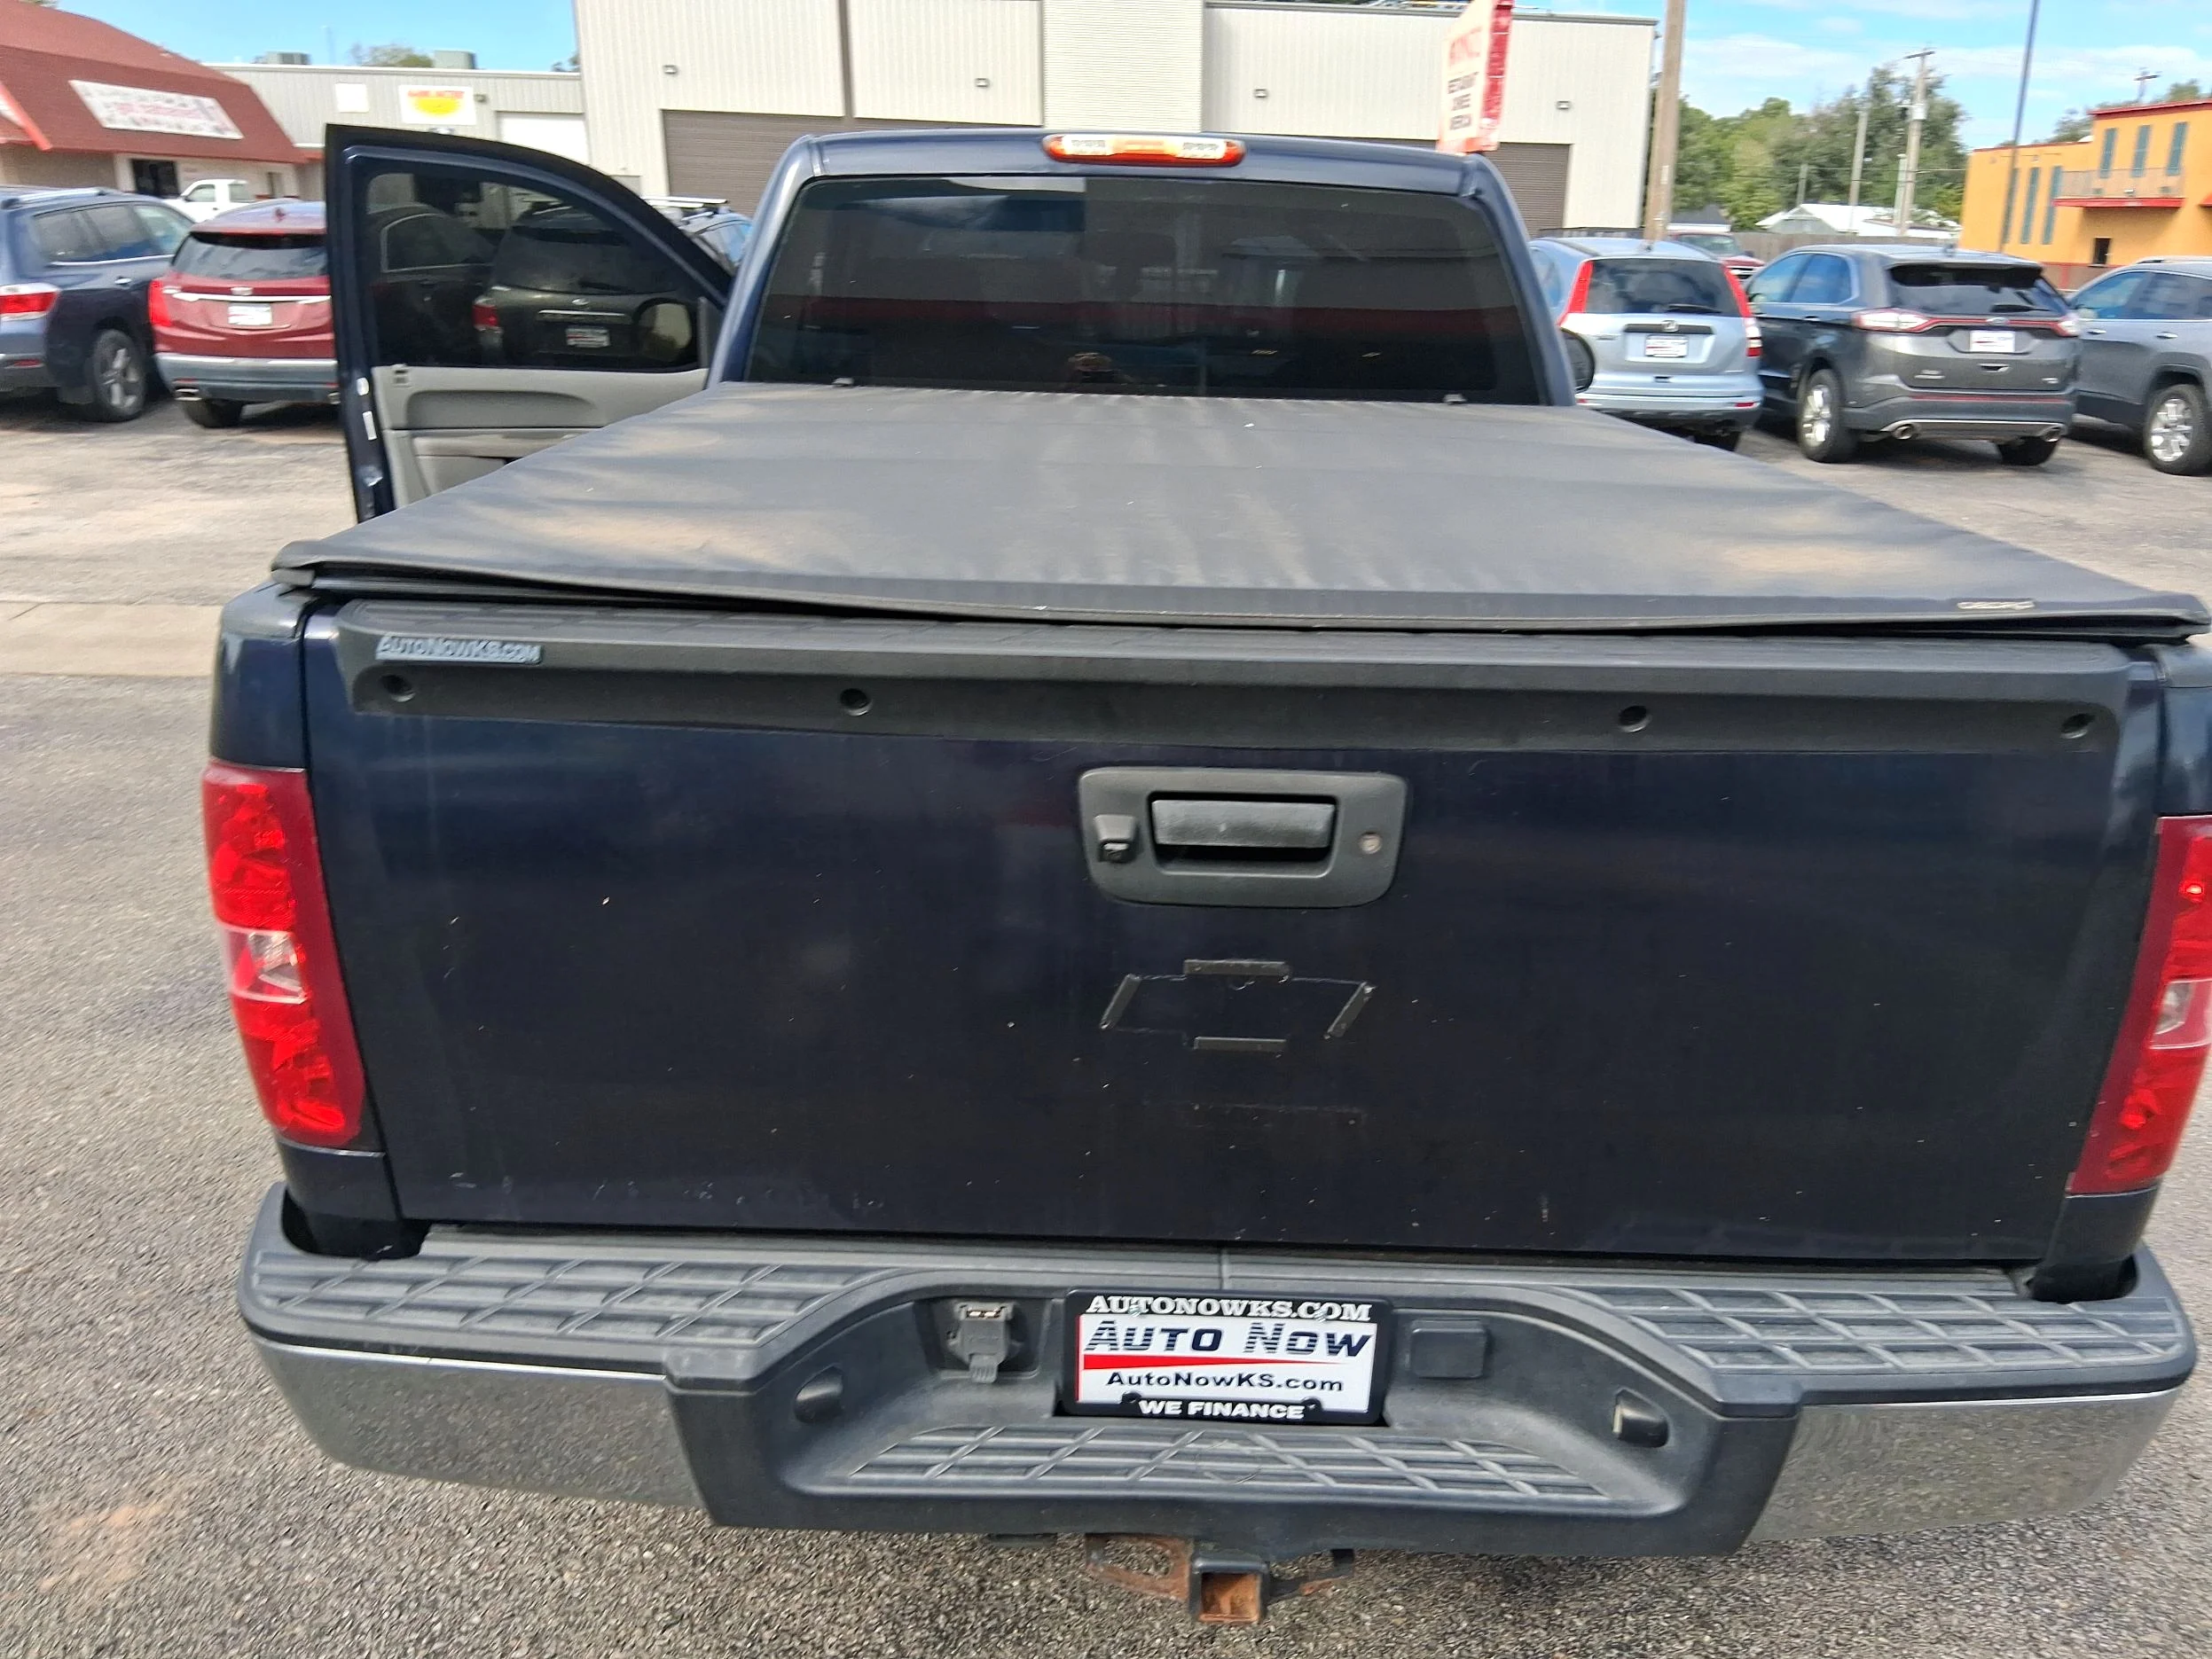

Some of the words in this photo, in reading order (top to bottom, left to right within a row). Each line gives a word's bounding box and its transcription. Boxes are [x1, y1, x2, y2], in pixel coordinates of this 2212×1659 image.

[1086, 1295, 1372, 1322] AUTONOWKS.COM
[1106, 1372, 1343, 1391] AutoNowKS.com
[1138, 1399, 1182, 1416] WE
[1188, 1400, 1306, 1420] FINANCE
